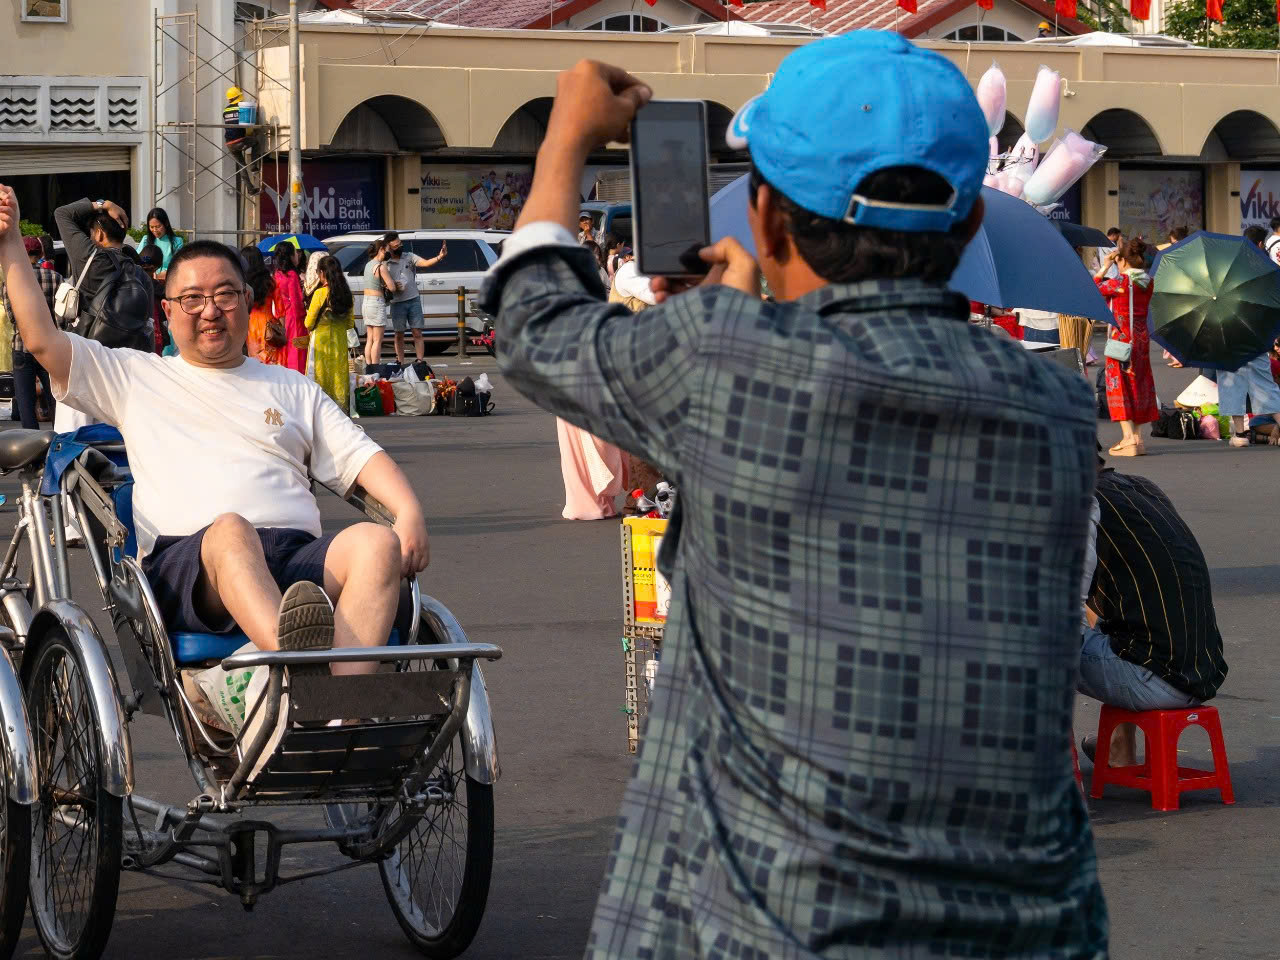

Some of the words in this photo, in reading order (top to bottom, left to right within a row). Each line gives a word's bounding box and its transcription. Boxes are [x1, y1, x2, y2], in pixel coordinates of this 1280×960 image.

[264, 186, 336, 219] Vkki
[339, 197, 363, 207] Digital
[339, 206, 371, 219] Bank
[339, 221, 351, 230] Tốt
